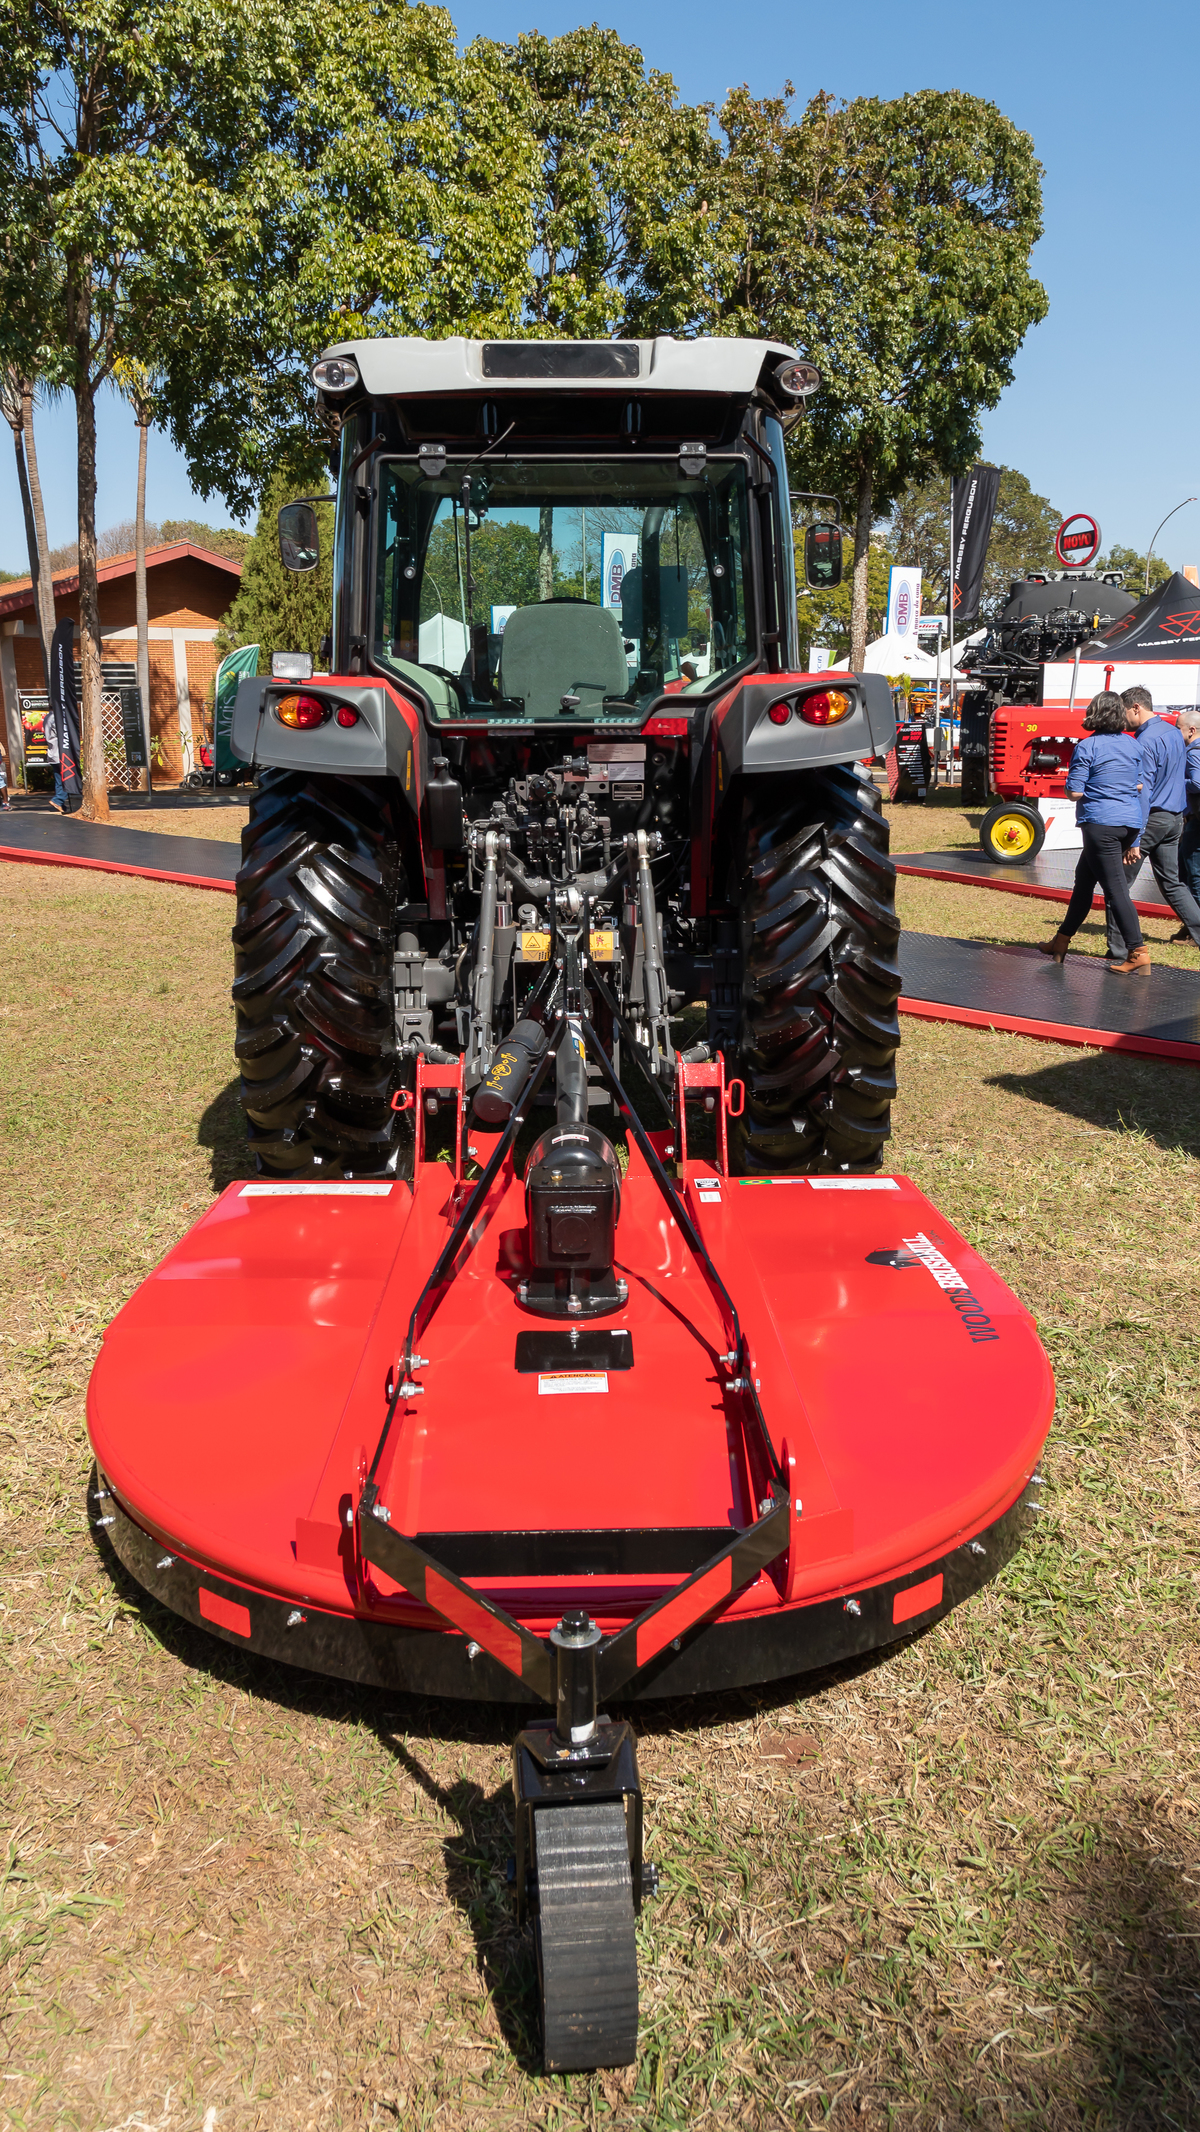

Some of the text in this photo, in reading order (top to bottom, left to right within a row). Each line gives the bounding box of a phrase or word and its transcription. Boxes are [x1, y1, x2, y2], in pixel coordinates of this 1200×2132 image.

[954, 479, 978, 580] MASSEY FERGUSON
[1063, 532, 1092, 550] NOVO
[611, 564, 622, 603] DMB
[897, 593, 909, 626] DMB
[1137, 639, 1181, 648] MASSEY
[58, 643, 66, 702] FERGUSON
[1026, 724, 1038, 732] 30
[943, 1287, 1000, 1343] WOODS
